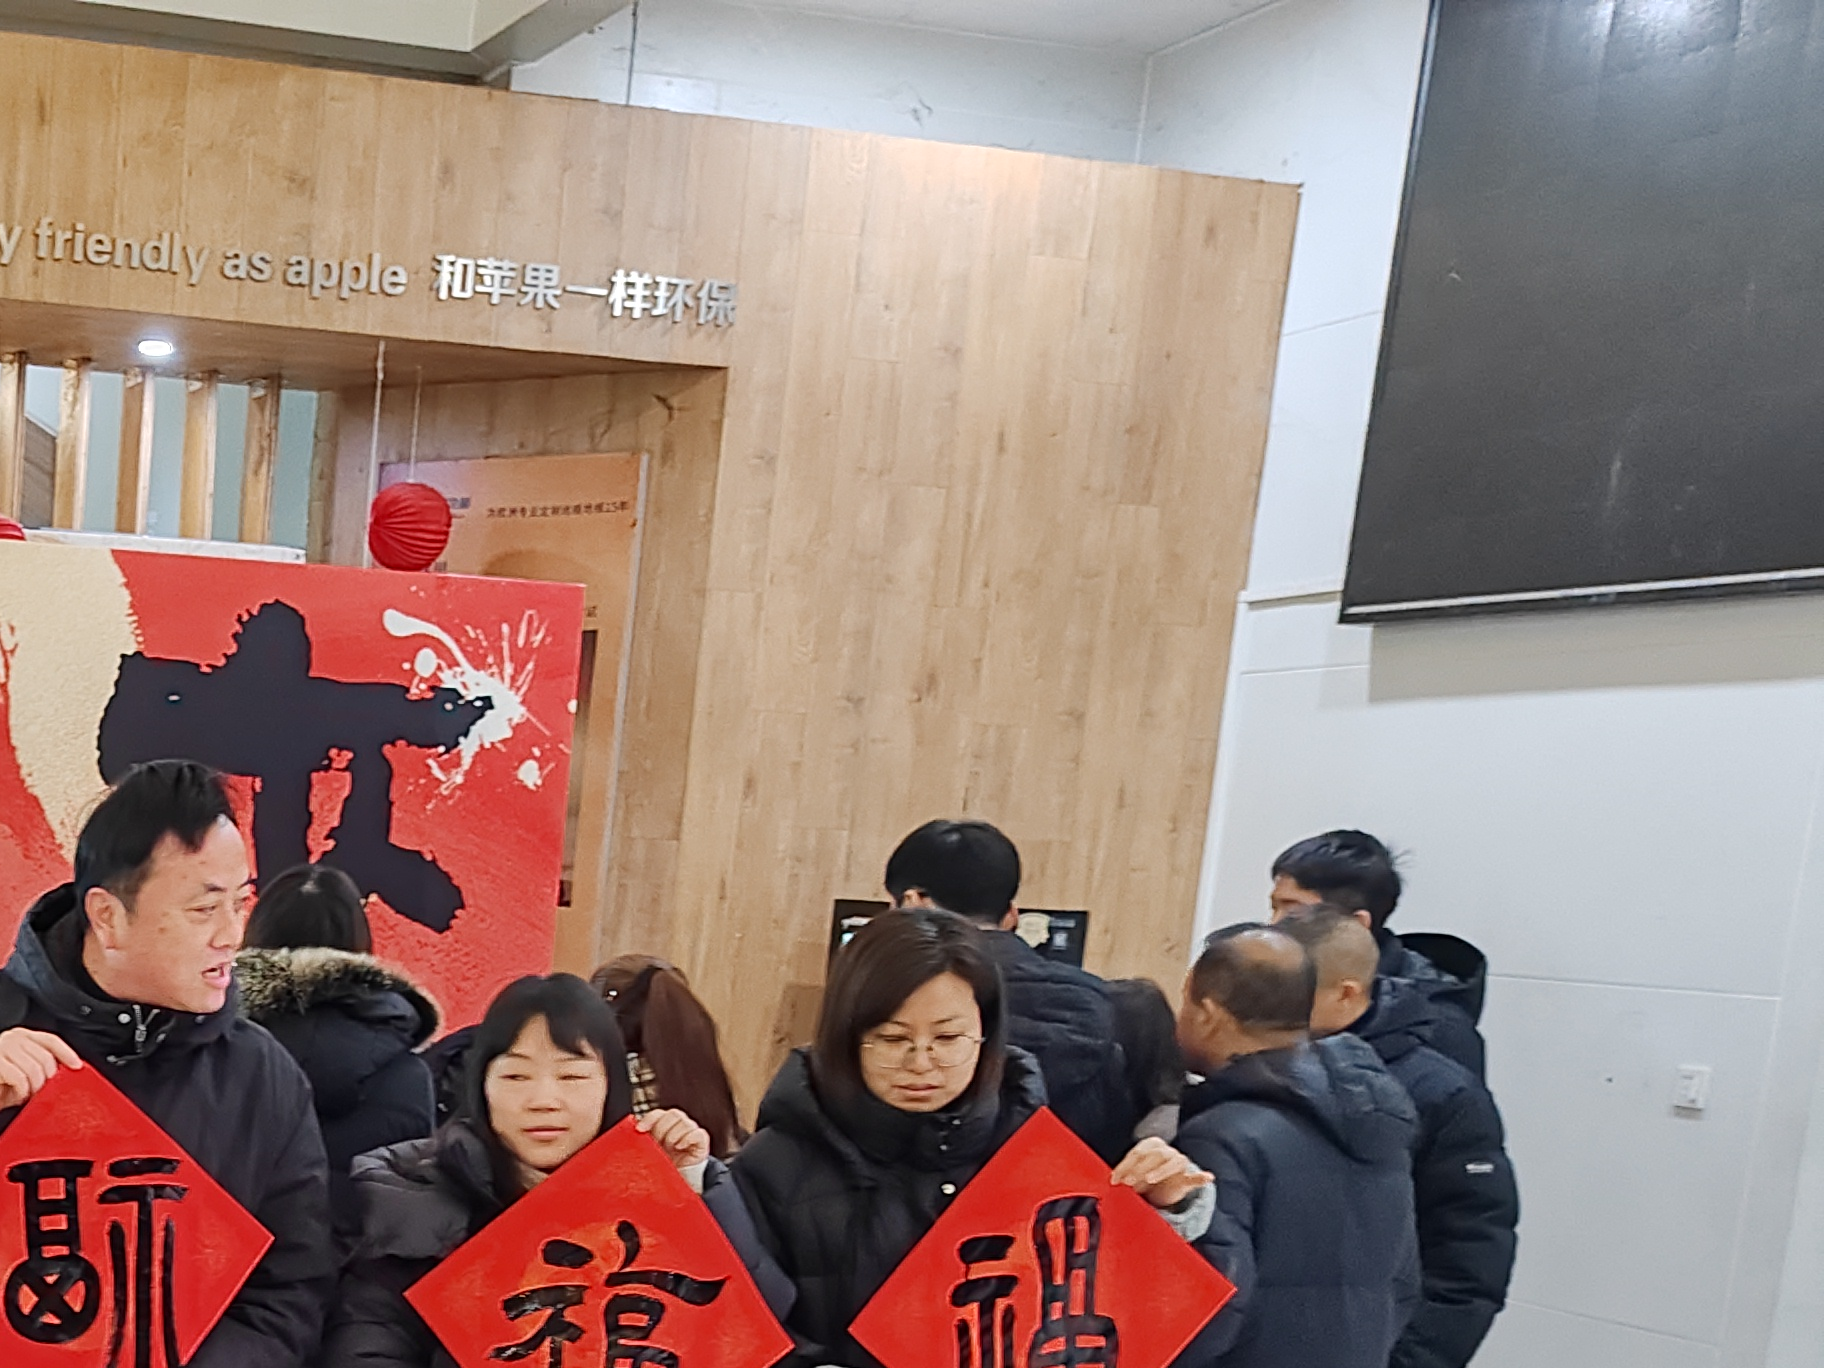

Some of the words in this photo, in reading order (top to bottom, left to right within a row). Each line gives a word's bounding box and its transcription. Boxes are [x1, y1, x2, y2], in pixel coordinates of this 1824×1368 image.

[34, 216, 210, 285] friendly
[222, 243, 273, 282] as
[284, 251, 410, 298] apple
[432, 252, 738, 327] 和苹果一样环保
